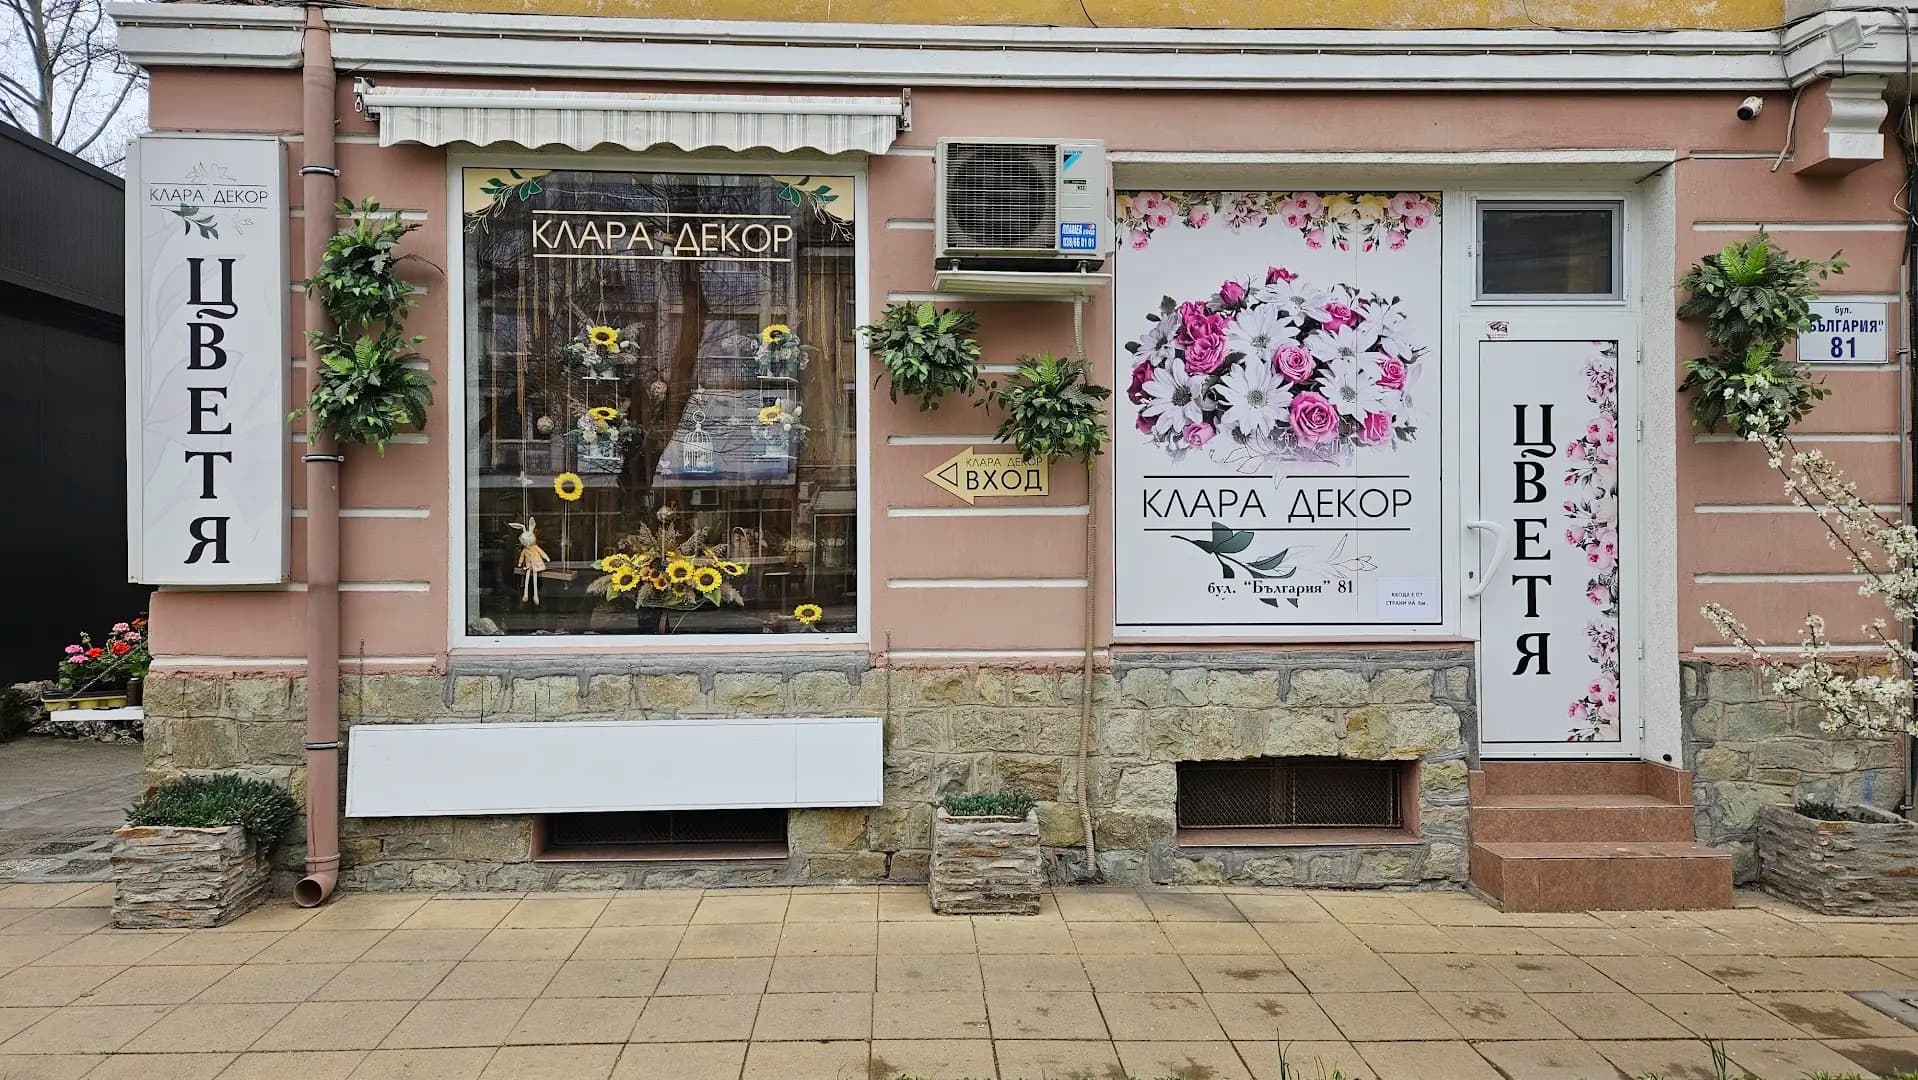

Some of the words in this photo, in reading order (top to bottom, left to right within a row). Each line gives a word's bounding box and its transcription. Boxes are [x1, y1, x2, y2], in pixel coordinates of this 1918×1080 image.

[149, 187, 205, 203] КЛАРА
[213, 189, 269, 205] ДЕКОР
[532, 219, 654, 250] КЛАРА
[673, 222, 794, 257] ДЕКОР
[1834, 305, 1852, 316] бул.
[1808, 319, 1884, 333] БЪЛГАРИЯ"
[1830, 336, 1856, 358] 81
[183, 257, 239, 565] ЦВЕТЯ
[965, 457, 1001, 468] КЛАРА
[966, 469, 1043, 492] ВХОД
[1142, 488, 1267, 519] КЛАРА
[1287, 487, 1413, 524] ДЕКОР
[1511, 404, 1557, 676] ЦВЕТЯ
[1207, 582, 1236, 597] бул.
[1337, 579, 1354, 594] 81
